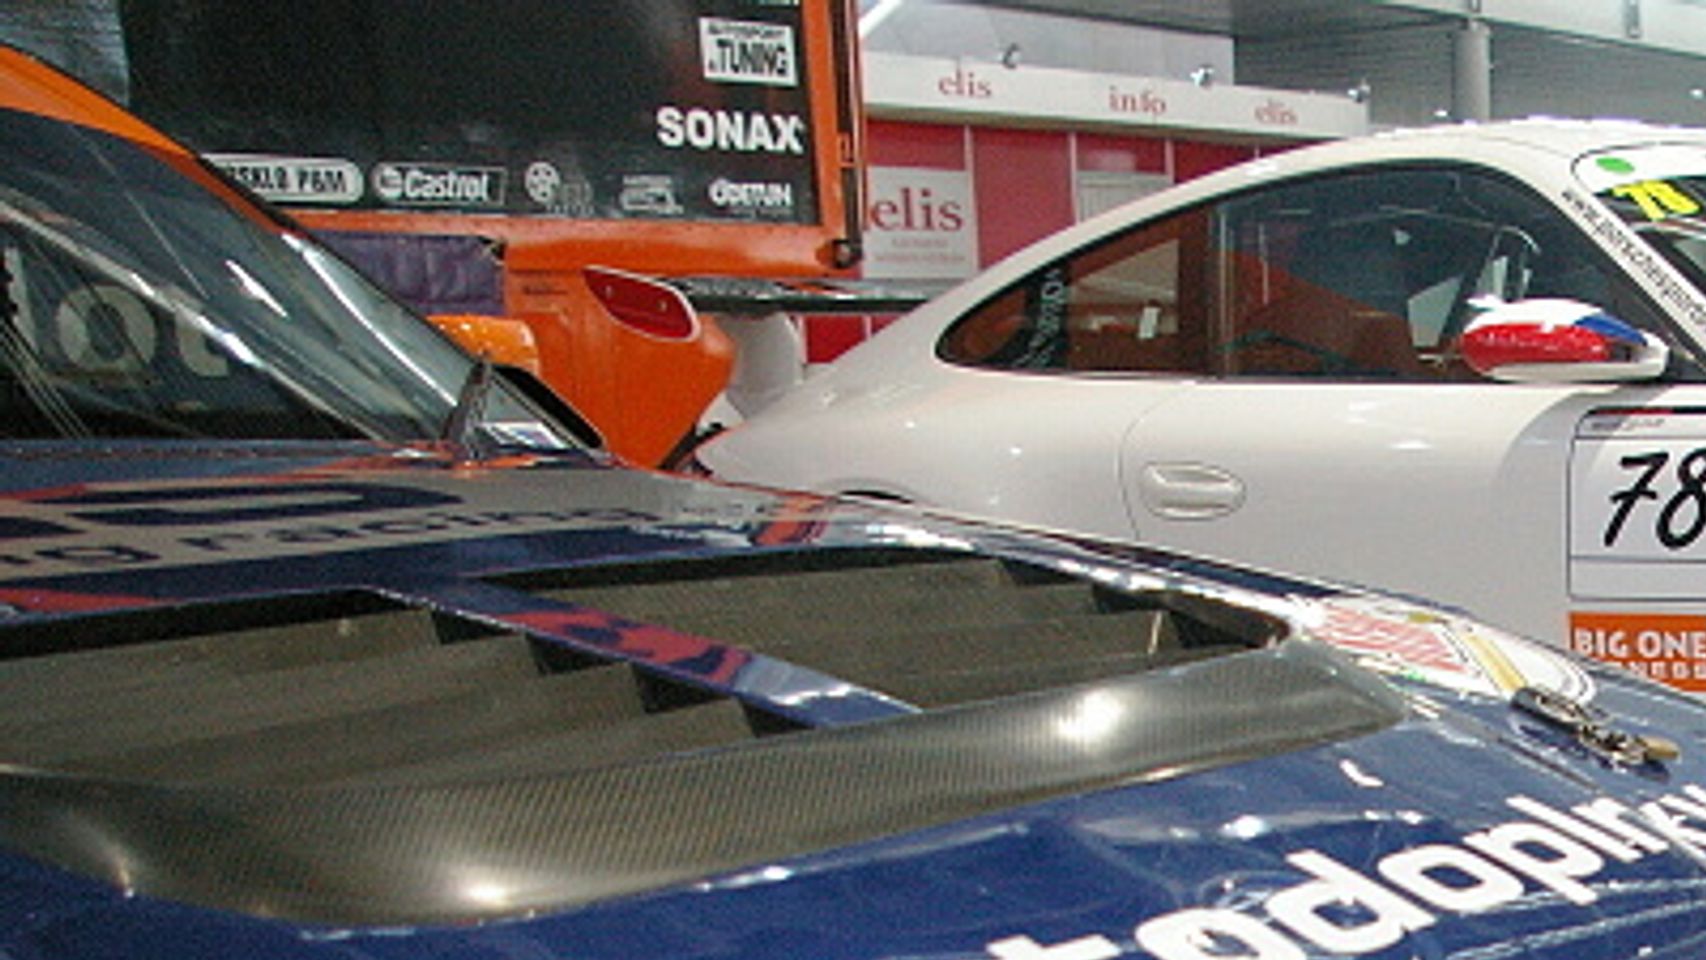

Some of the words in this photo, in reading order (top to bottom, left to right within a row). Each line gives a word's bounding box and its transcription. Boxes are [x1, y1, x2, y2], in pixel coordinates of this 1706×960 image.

[717, 38, 787, 76] TUNING
[938, 69, 993, 99] elis
[1109, 85, 1168, 120] info
[1253, 99, 1299, 126] elis
[656, 106, 805, 154] SONAX
[404, 167, 489, 201] Castrol
[872, 187, 965, 232] elis
[1573, 627, 1630, 658] BIG
